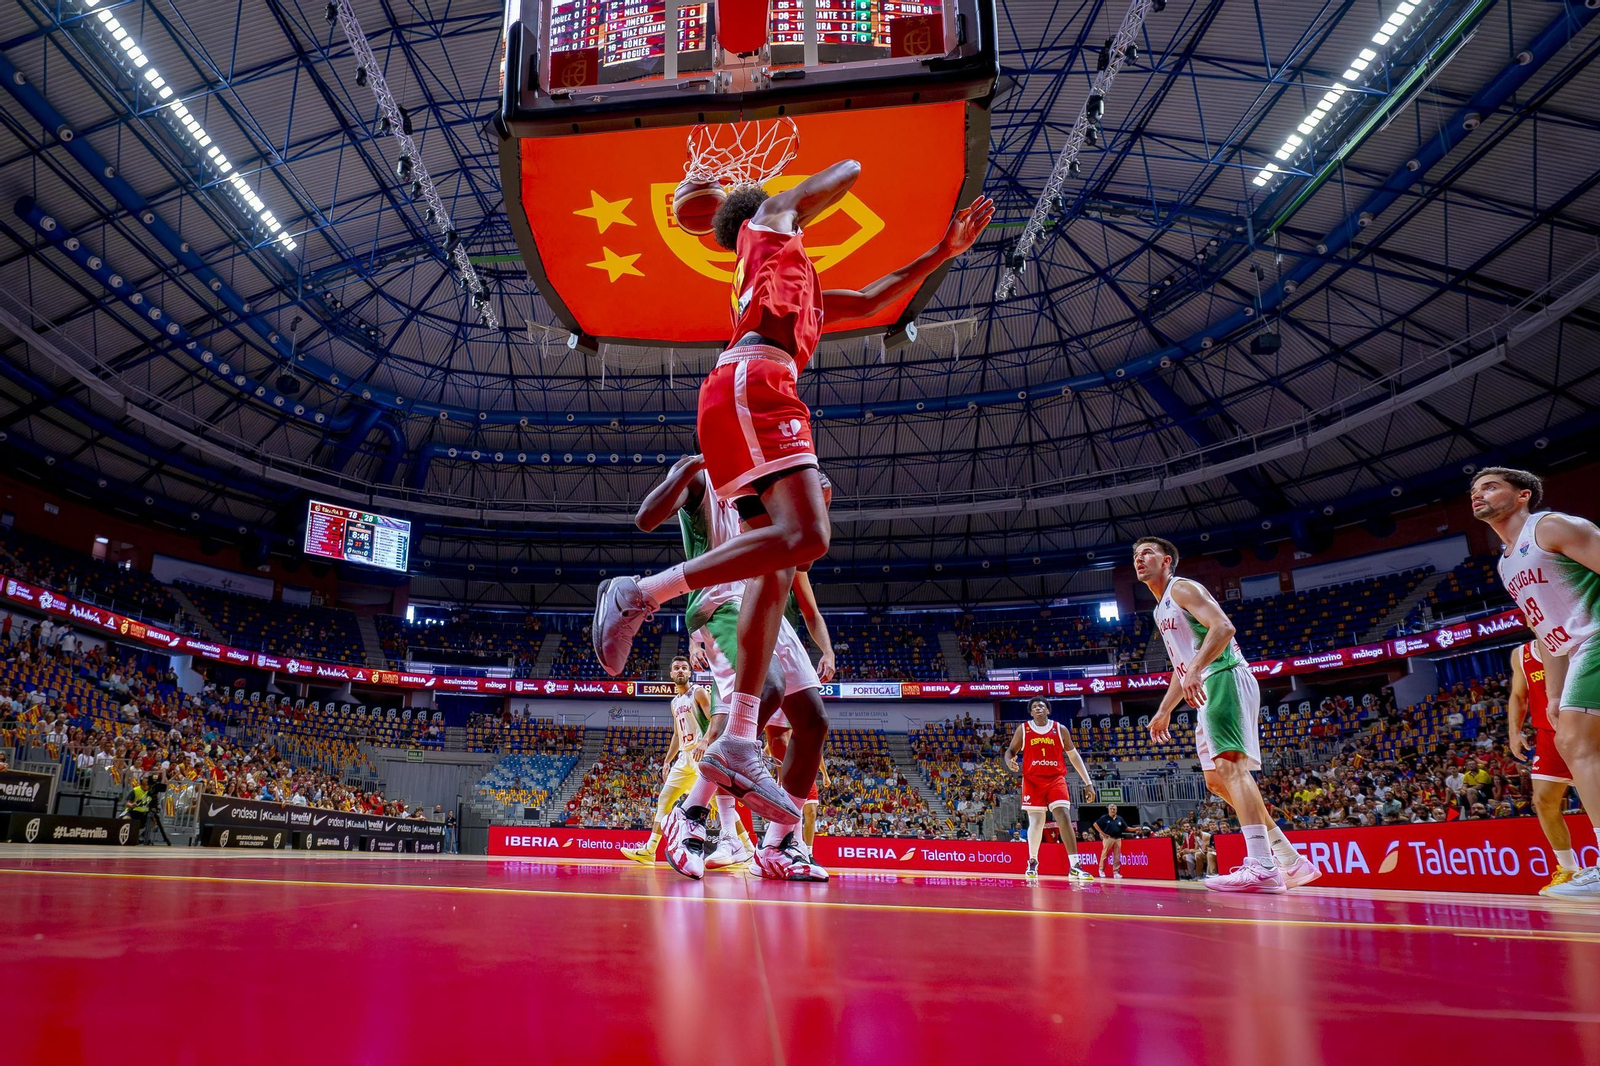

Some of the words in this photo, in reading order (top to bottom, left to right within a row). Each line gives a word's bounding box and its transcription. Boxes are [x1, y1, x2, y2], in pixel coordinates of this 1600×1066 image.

[624, 5, 648, 17] MILLER
[901, 4, 921, 13] NUNO
[624, 15, 653, 27] JIMÉNEZ
[348, 511, 358, 519] 18
[364, 514, 374, 522] 28
[147, 630, 171, 642] IBERIA
[186, 640, 221, 653] azulmarino
[1294, 654, 1342, 666] azulmarino
[1352, 648, 1383, 660] málaga
[401, 676, 426, 684] IBERIA
[443, 678, 478, 686] azulmarino
[643, 685, 672, 693] ESPAÑA
[819, 685, 834, 695] 28
[853, 687, 896, 695] PORTUGAL
[1018, 684, 1044, 692] málaga
[1030, 737, 1055, 746] ESPAÑA
[1041, 748, 1046, 756] 1
[1031, 759, 1058, 767] endesa
[231, 806, 257, 819] endesa
[53, 826, 108, 839] #LaFamilia
[505, 836, 559, 847] IBERIA
[576, 838, 613, 849] Talento
[615, 841, 621, 849] a
[838, 847, 897, 859] IBERIA
[921, 849, 966, 862] Talento
[968, 852, 976, 862] a
[978, 851, 1012, 864] bordo
[1078, 853, 1098, 865] BERIA
[1131, 852, 1149, 866] bordo
[1294, 841, 1370, 874] ERIA
[1408, 838, 1520, 876] Talento
[1528, 846, 1550, 877] a
